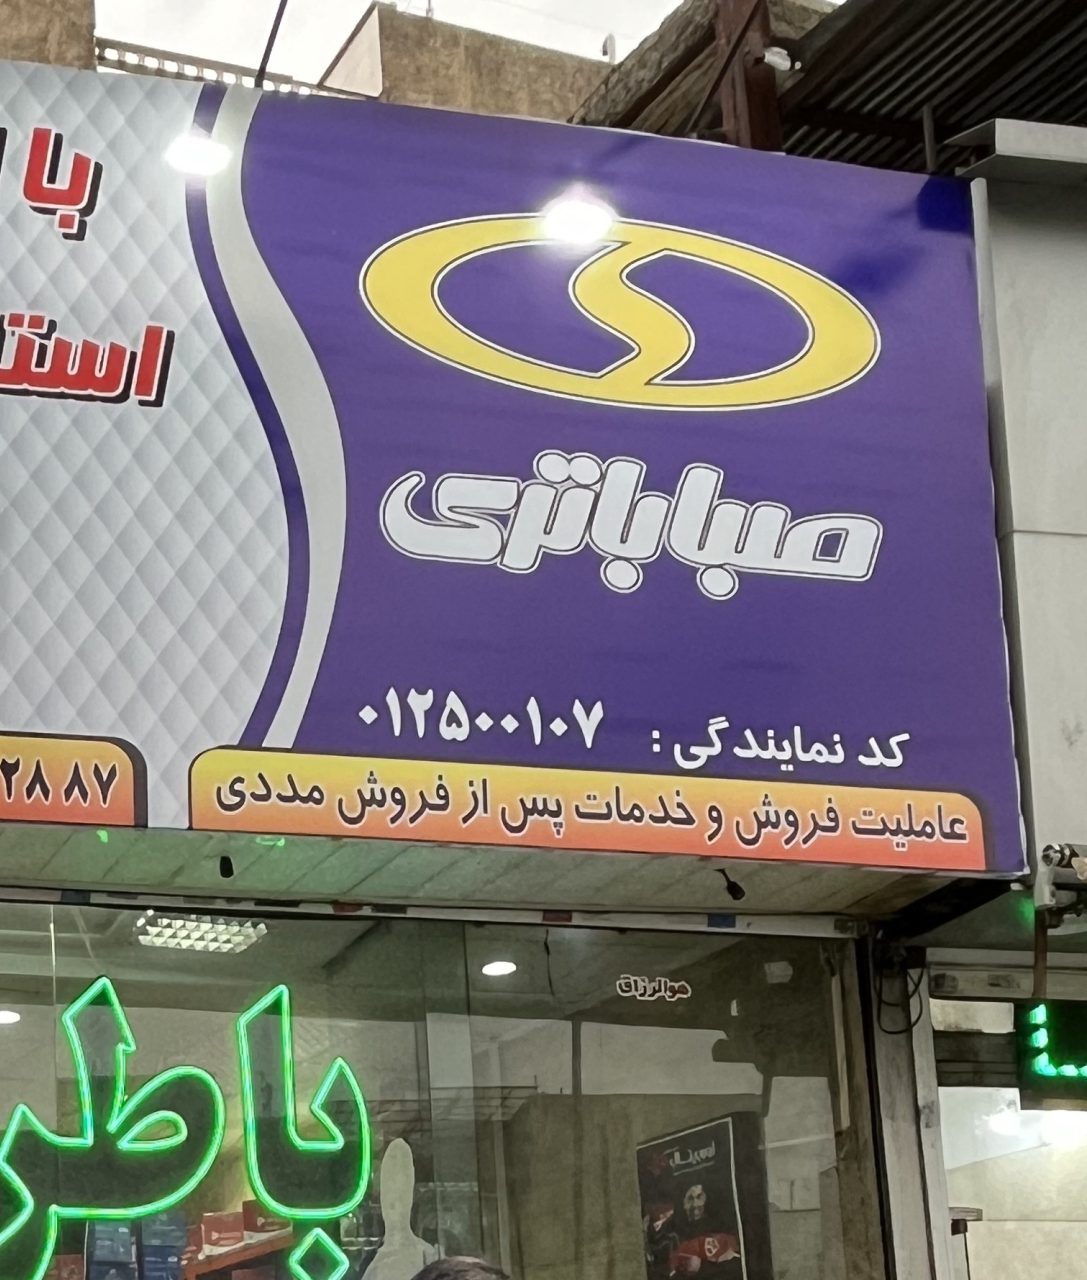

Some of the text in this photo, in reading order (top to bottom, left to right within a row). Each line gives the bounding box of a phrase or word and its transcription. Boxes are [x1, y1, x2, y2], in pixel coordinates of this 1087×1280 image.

[22, 124, 100, 238] با
[358, 686, 604, 749] ۰۱۲۵۰۰۱۰۷
[856, 732, 911, 769] کد
[215, 770, 968, 851] عاملیت فروش و خدمات پس از فروش مددی
